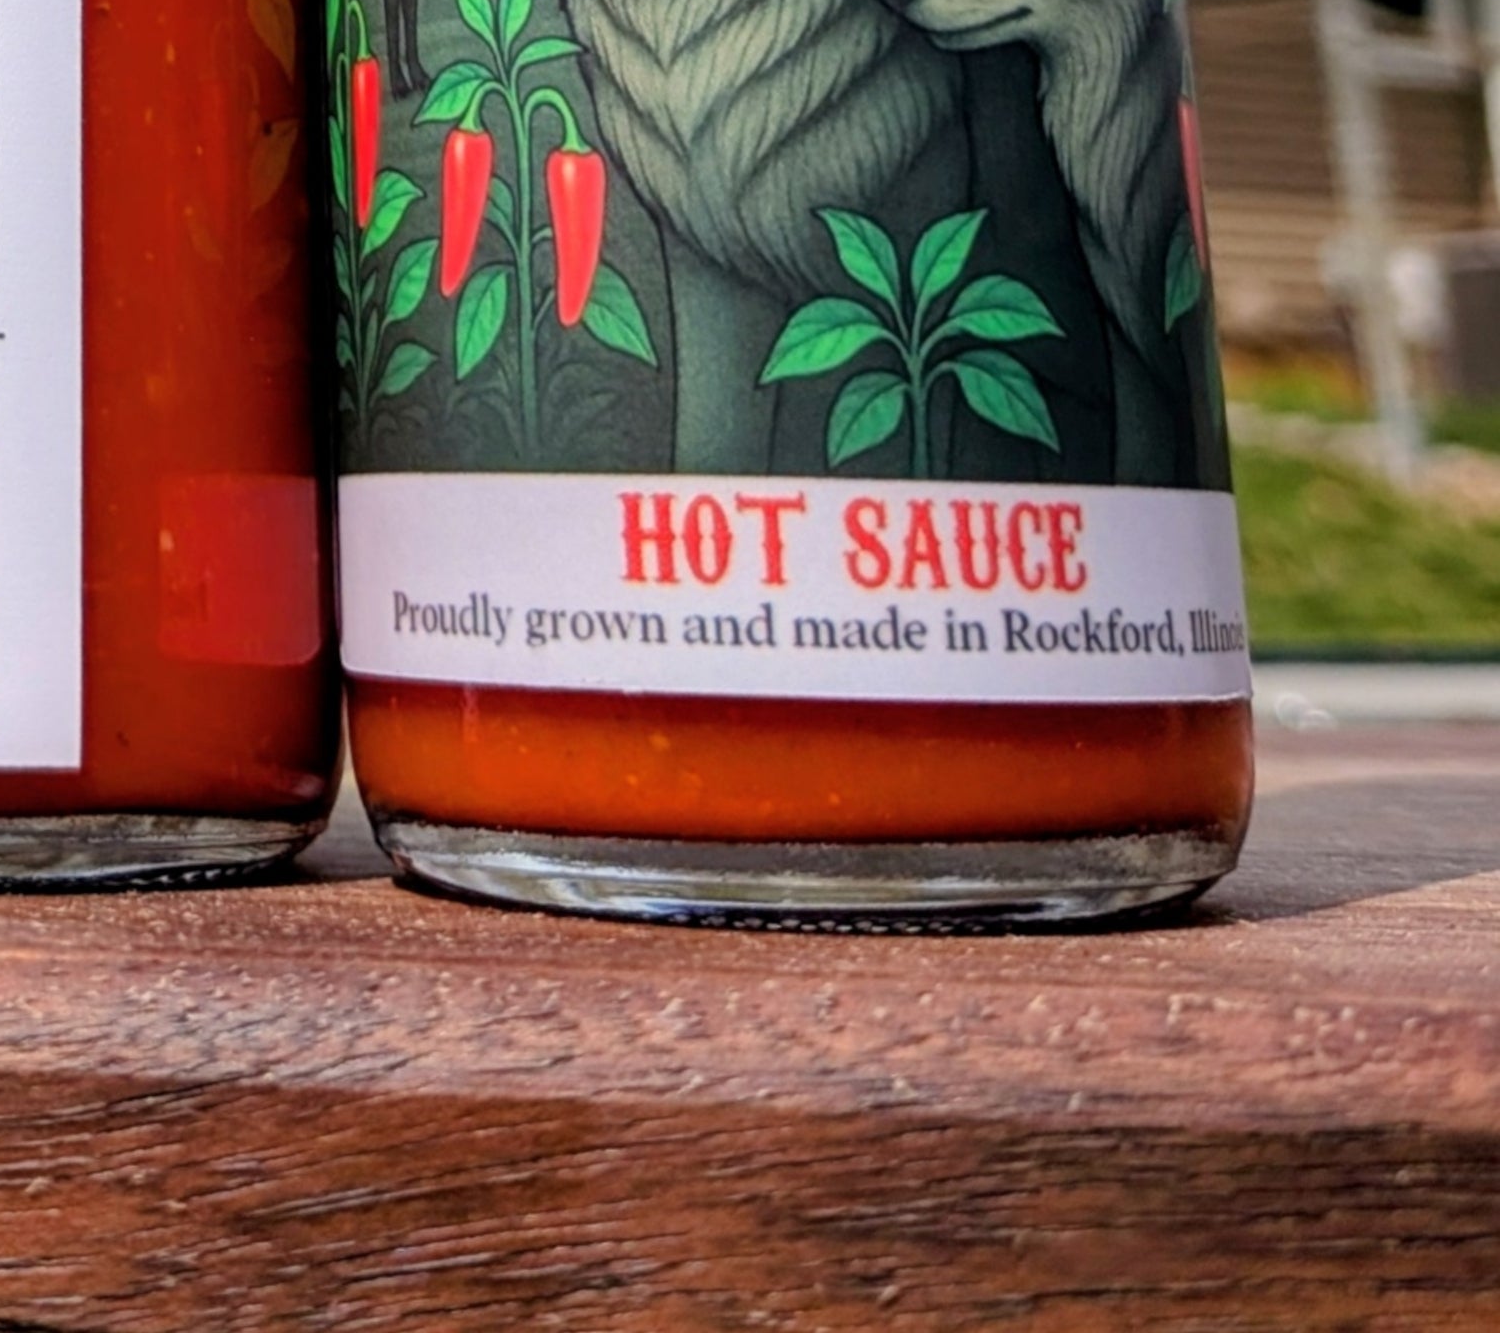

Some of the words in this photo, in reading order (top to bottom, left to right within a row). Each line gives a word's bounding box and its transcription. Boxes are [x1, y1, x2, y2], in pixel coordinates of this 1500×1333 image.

[620, 491, 807, 587] HOT
[842, 497, 1087, 593] SAUCE
[393, 590, 513, 647] Proudly
[525, 608, 668, 649] grown
[682, 602, 777, 648] and
[793, 604, 928, 652] made
[945, 608, 989, 653] in
[1000, 607, 1185, 657] Rockford,
